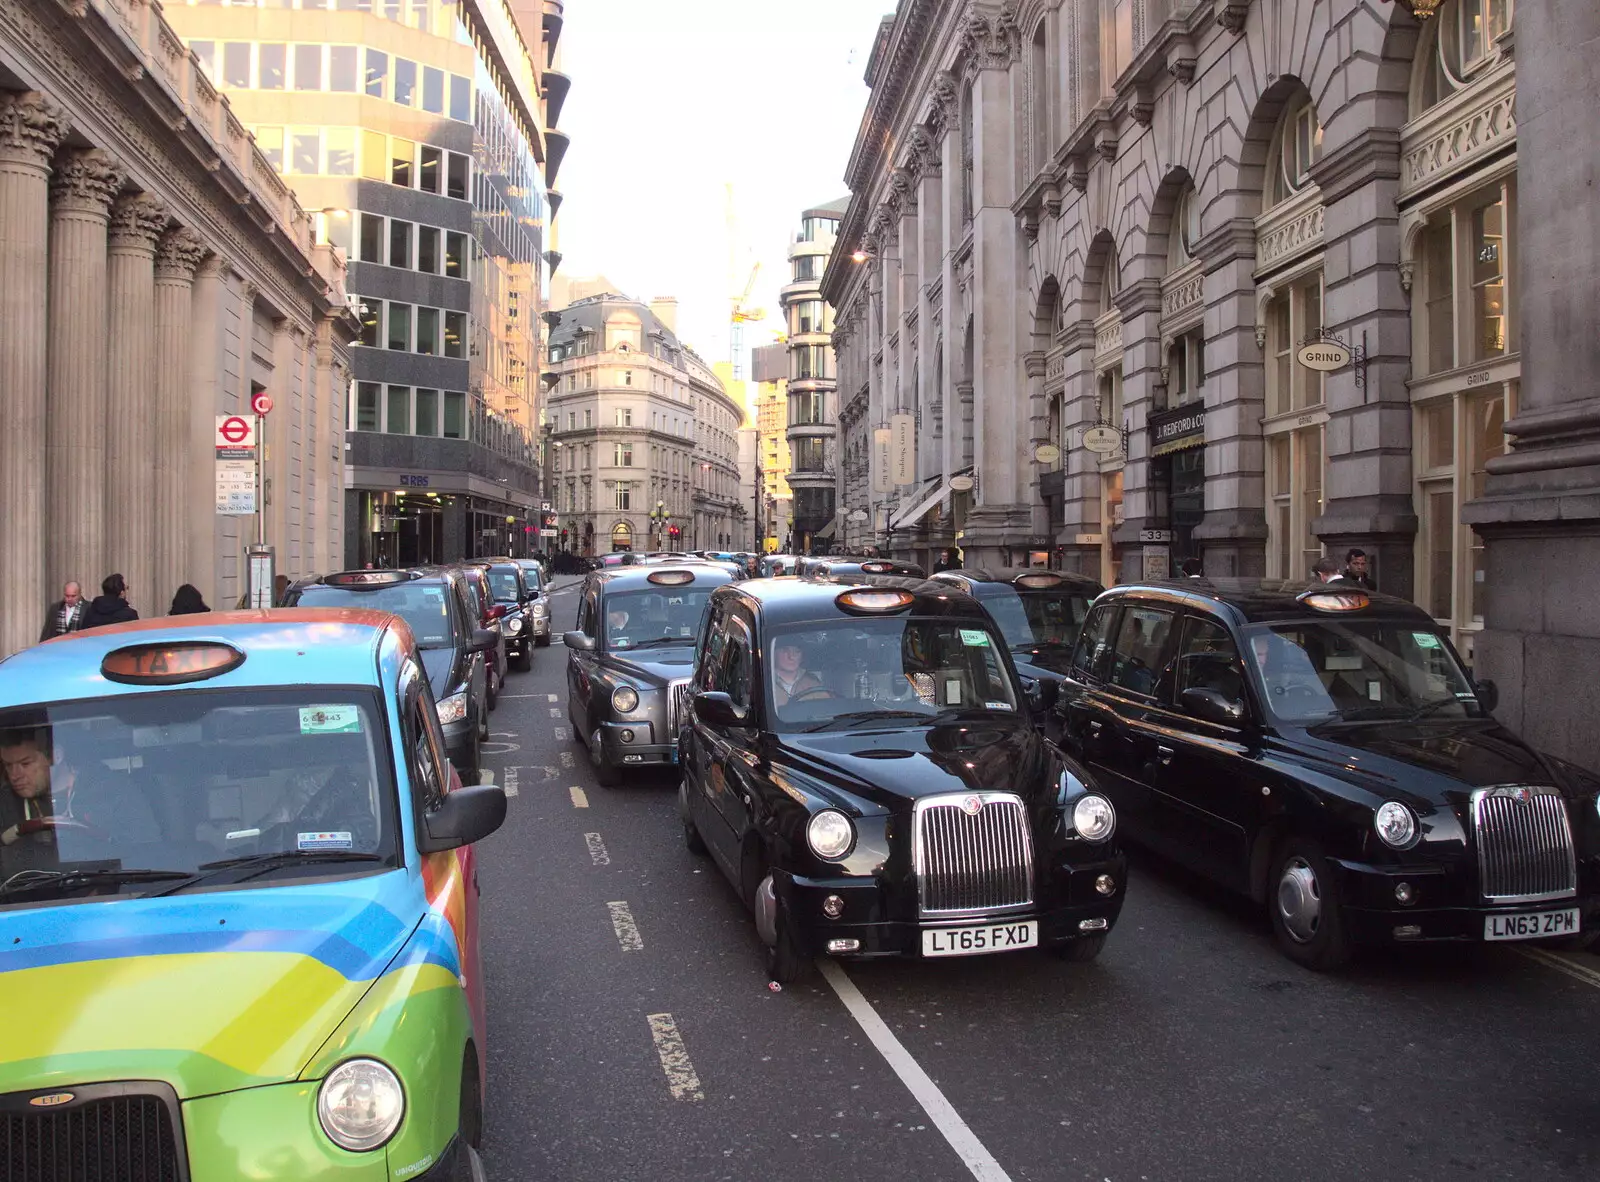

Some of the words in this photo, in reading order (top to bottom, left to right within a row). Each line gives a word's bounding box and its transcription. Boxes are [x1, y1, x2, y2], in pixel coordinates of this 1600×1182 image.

[1305, 352, 1342, 362] GRIND
[1467, 371, 1490, 386] GRIND
[254, 396, 269, 413] C
[1163, 417, 1191, 437] REDFORD
[898, 447, 907, 478] Shopping
[410, 475, 429, 487] RBS
[1085, 535, 1093, 543] 31
[1147, 530, 1162, 540] 33
[129, 646, 209, 674] TAXI
[1492, 915, 1540, 937] LN63
[1543, 911, 1574, 933] ZPM
[932, 928, 987, 952] LT65
[991, 924, 1030, 947] FXD
